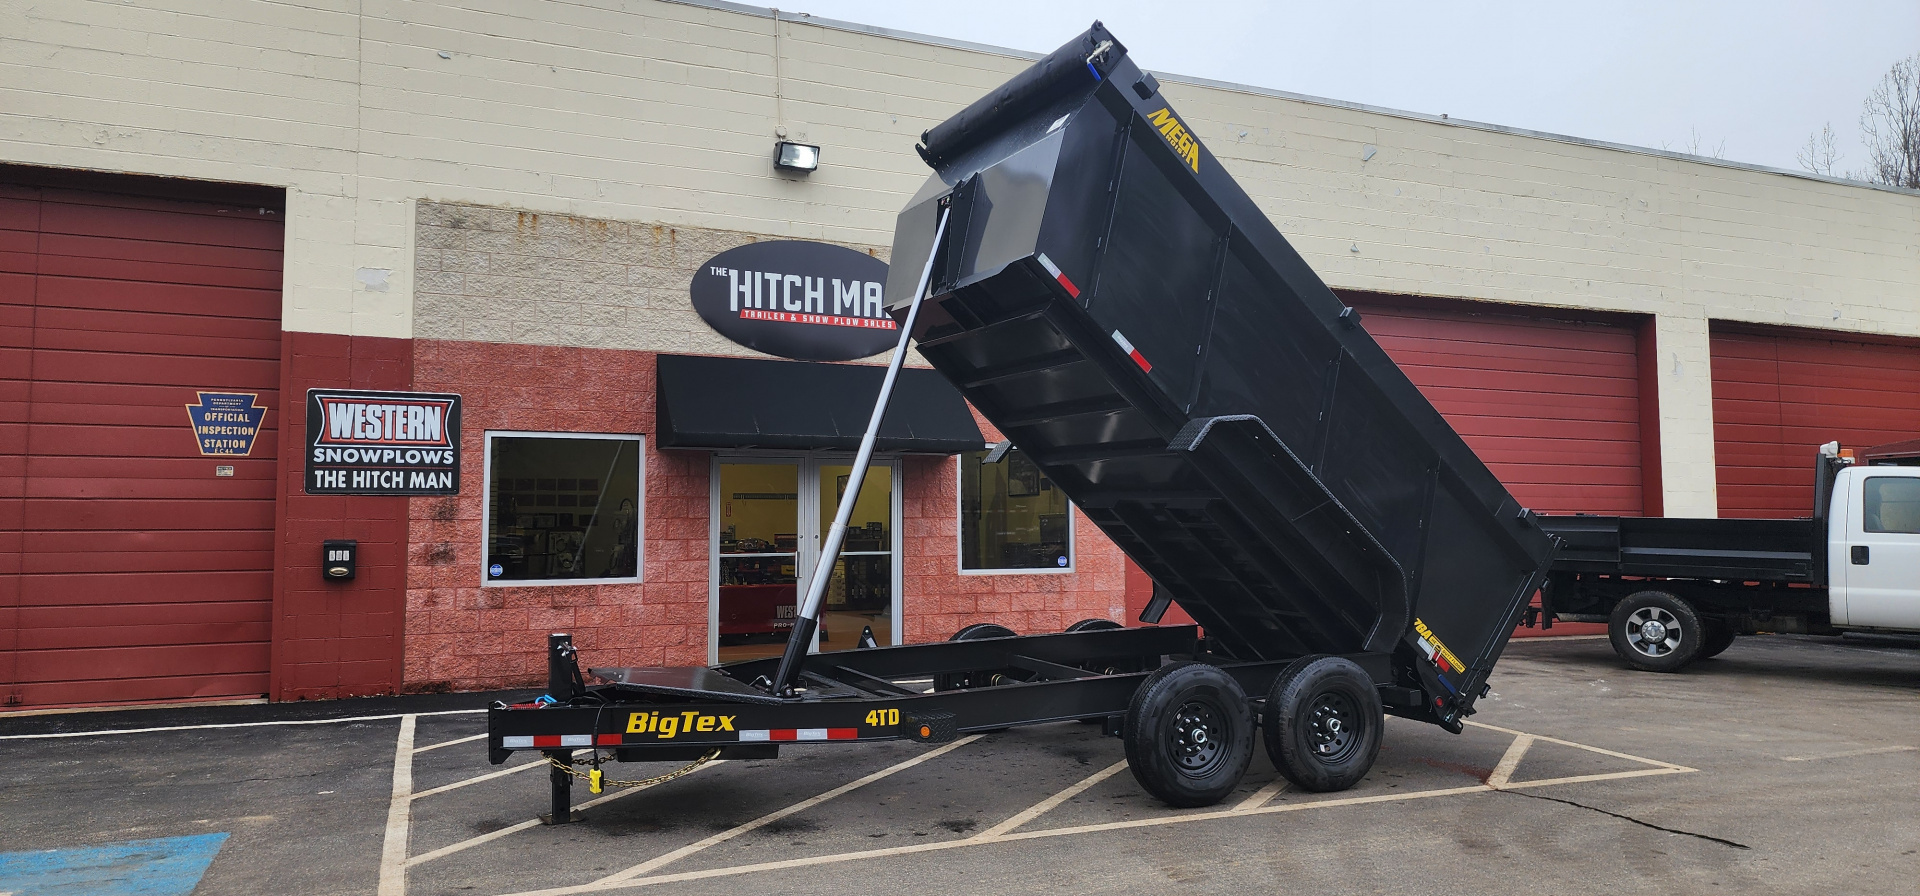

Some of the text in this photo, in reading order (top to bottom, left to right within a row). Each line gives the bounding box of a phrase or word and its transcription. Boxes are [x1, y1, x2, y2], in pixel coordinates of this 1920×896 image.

[1147, 107, 1199, 174] MEGA
[710, 266, 892, 319] THE HITCH MA
[744, 310, 893, 329] TRAILER & SNOW PLOW SALES
[204, 412, 250, 422] OFFICIAL
[328, 402, 441, 441] WESTERN
[198, 425, 254, 435] INSPECTION
[204, 439, 246, 448] STATION
[313, 448, 454, 464] SNOWPLOWS
[314, 470, 452, 489] THE HITCH MAN
[776, 605, 797, 619] WEST
[1414, 617, 1433, 640] 7GA
[625, 711, 737, 739] BigTex
[865, 708, 900, 727] 4TD
